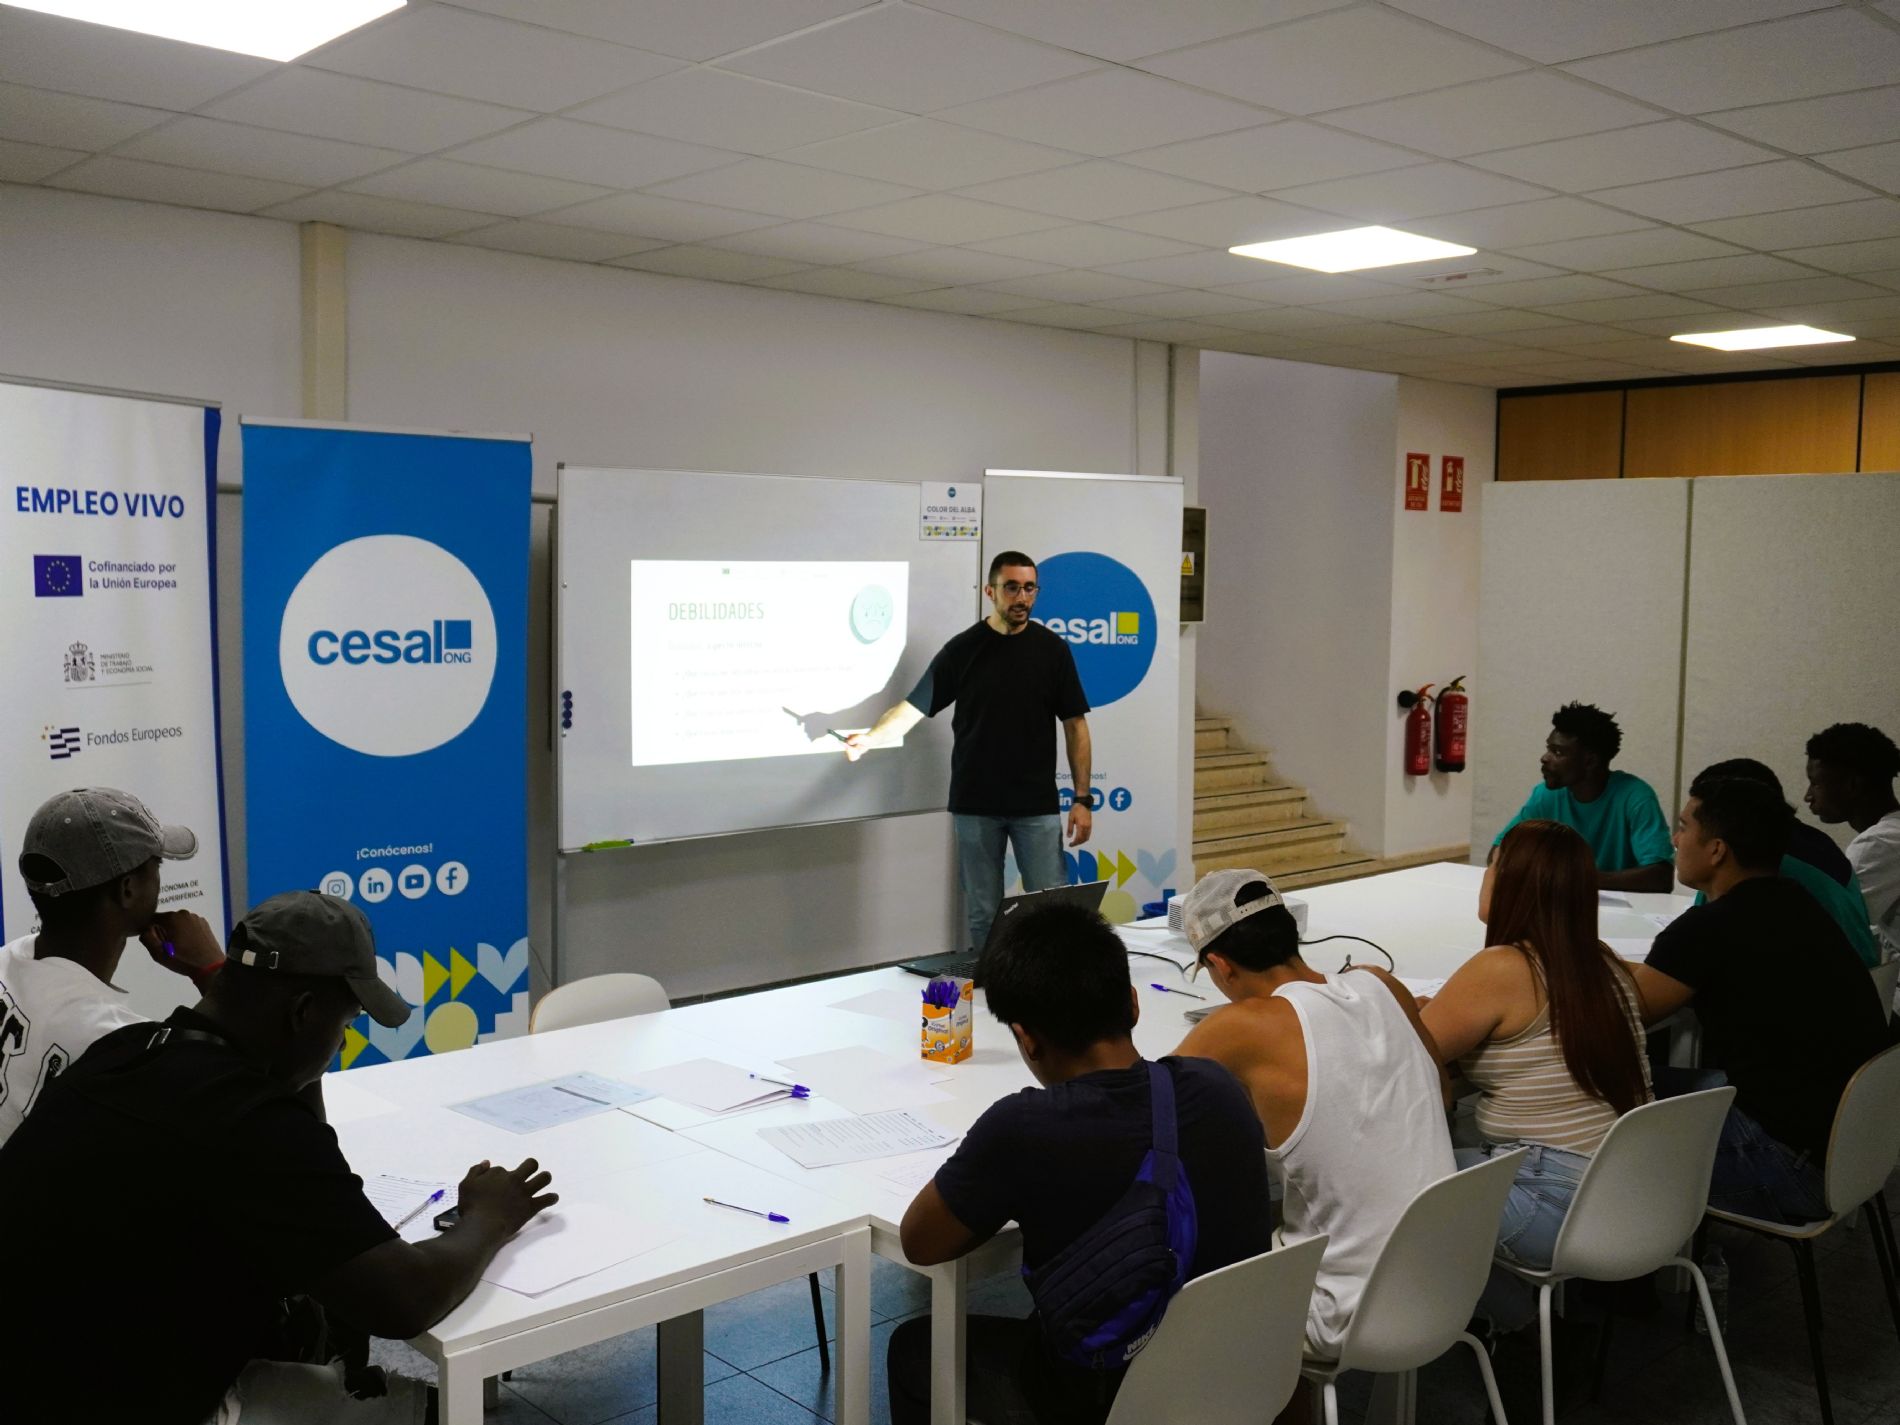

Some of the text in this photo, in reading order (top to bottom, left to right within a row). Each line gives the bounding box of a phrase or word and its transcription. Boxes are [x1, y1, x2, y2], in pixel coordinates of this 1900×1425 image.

[16, 486, 185, 518] EMPLEO VIVO
[926, 505, 948, 513] COLOR
[88, 560, 177, 575] Cofinanciado por
[89, 577, 177, 591] la Unión Europea
[668, 602, 765, 621] DEBILIDADES
[1029, 611, 1139, 645] esal ONG
[308, 619, 472, 666] cesal ONG
[87, 726, 183, 746] Fondos Europeos
[356, 842, 433, 861] ¡Conócenos!
[160, 880, 199, 893] TÓNOMA DE
[159, 890, 204, 904] RAPERIFÉRICA
